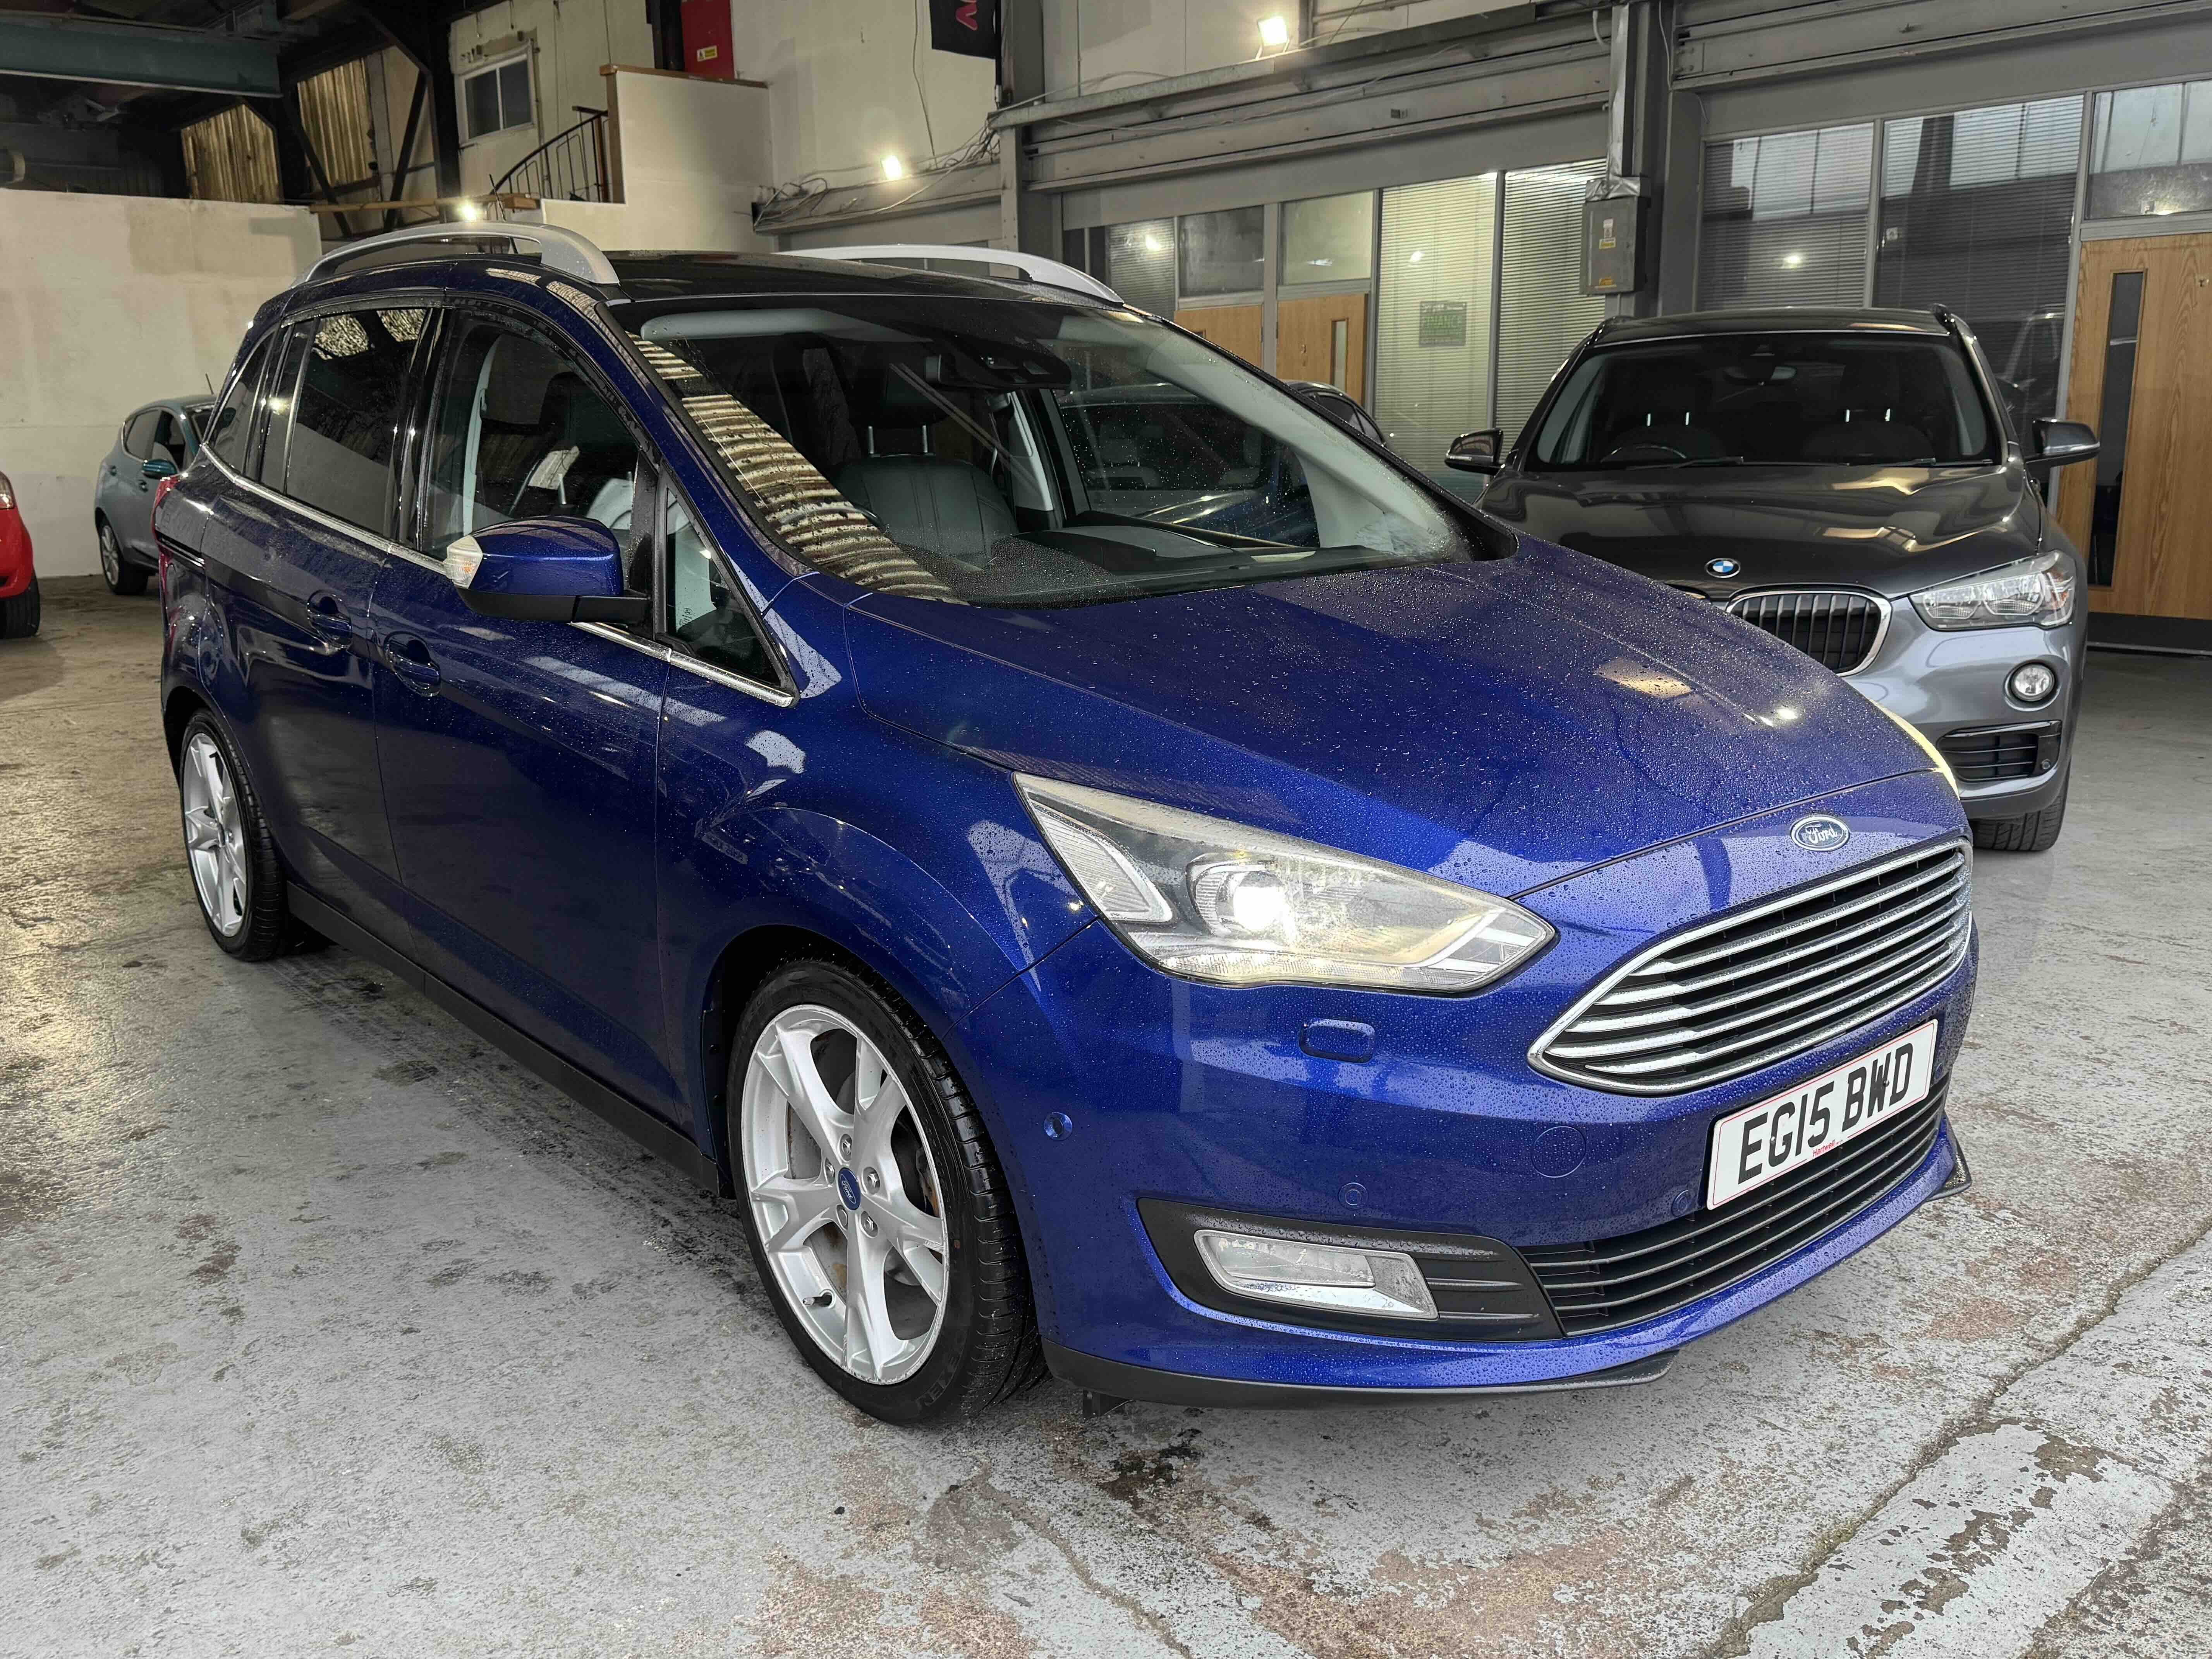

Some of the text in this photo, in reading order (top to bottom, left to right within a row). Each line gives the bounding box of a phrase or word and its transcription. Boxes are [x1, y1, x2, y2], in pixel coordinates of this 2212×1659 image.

[1805, 824, 1838, 844] Ford
[1738, 1043, 1913, 1185] EG15 BWD
[1812, 1139, 1835, 1157] Hartwell
[842, 1180, 854, 1200] Ford
